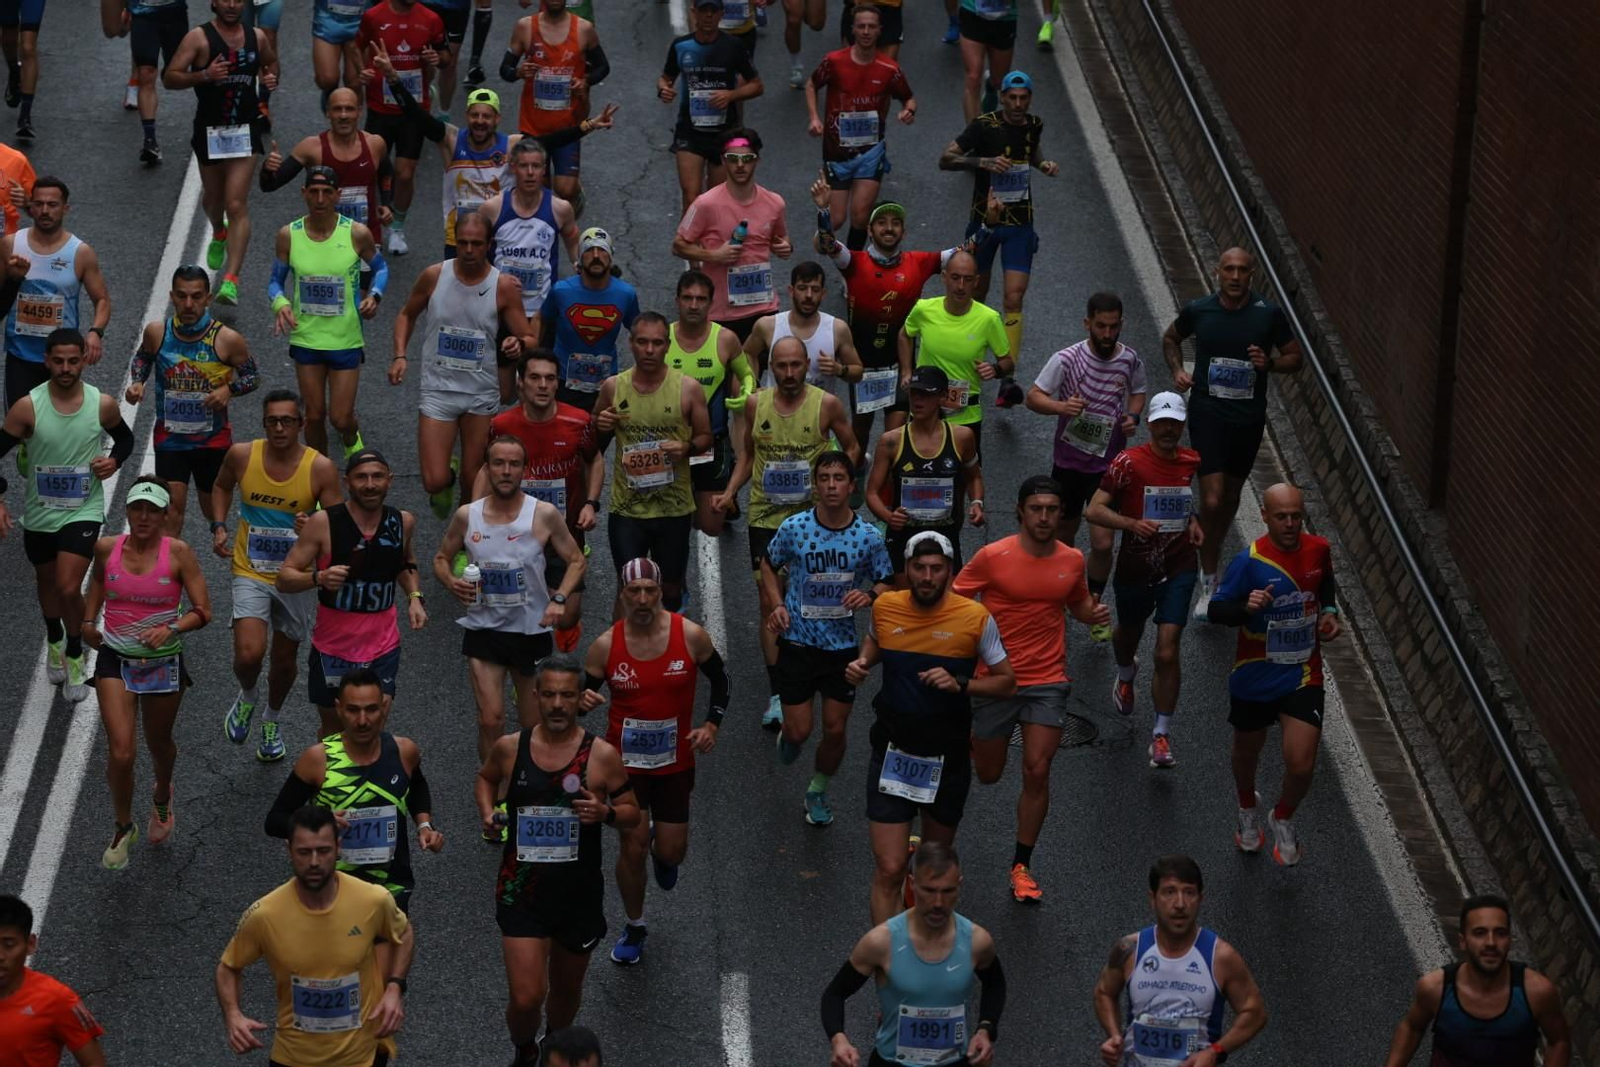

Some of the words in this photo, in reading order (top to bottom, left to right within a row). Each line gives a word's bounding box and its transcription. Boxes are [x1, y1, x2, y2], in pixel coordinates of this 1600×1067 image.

[845, 120, 870, 132] 3125
[735, 274, 763, 288] 2914
[306, 285, 334, 299] 1559
[22, 304, 53, 318] 4459
[444, 336, 475, 354] 3060
[172, 401, 202, 416] 2035
[1074, 419, 1102, 438] 7889
[630, 453, 661, 469] 5328
[46, 476, 78, 491] 1557
[768, 473, 800, 487] 3385
[250, 492, 284, 507] WEST
[289, 499, 298, 509] 4
[1153, 498, 1183, 512] 1558
[256, 538, 289, 554] 2633
[805, 548, 849, 574] COMO
[809, 584, 844, 600] 3402
[631, 731, 665, 747] 2537
[892, 757, 929, 779] 3107
[343, 821, 382, 840] 2171
[526, 820, 566, 839] 3268
[302, 991, 346, 1010] 2222
[910, 1021, 950, 1040] 1991
[1139, 1029, 1182, 1051] 2316
